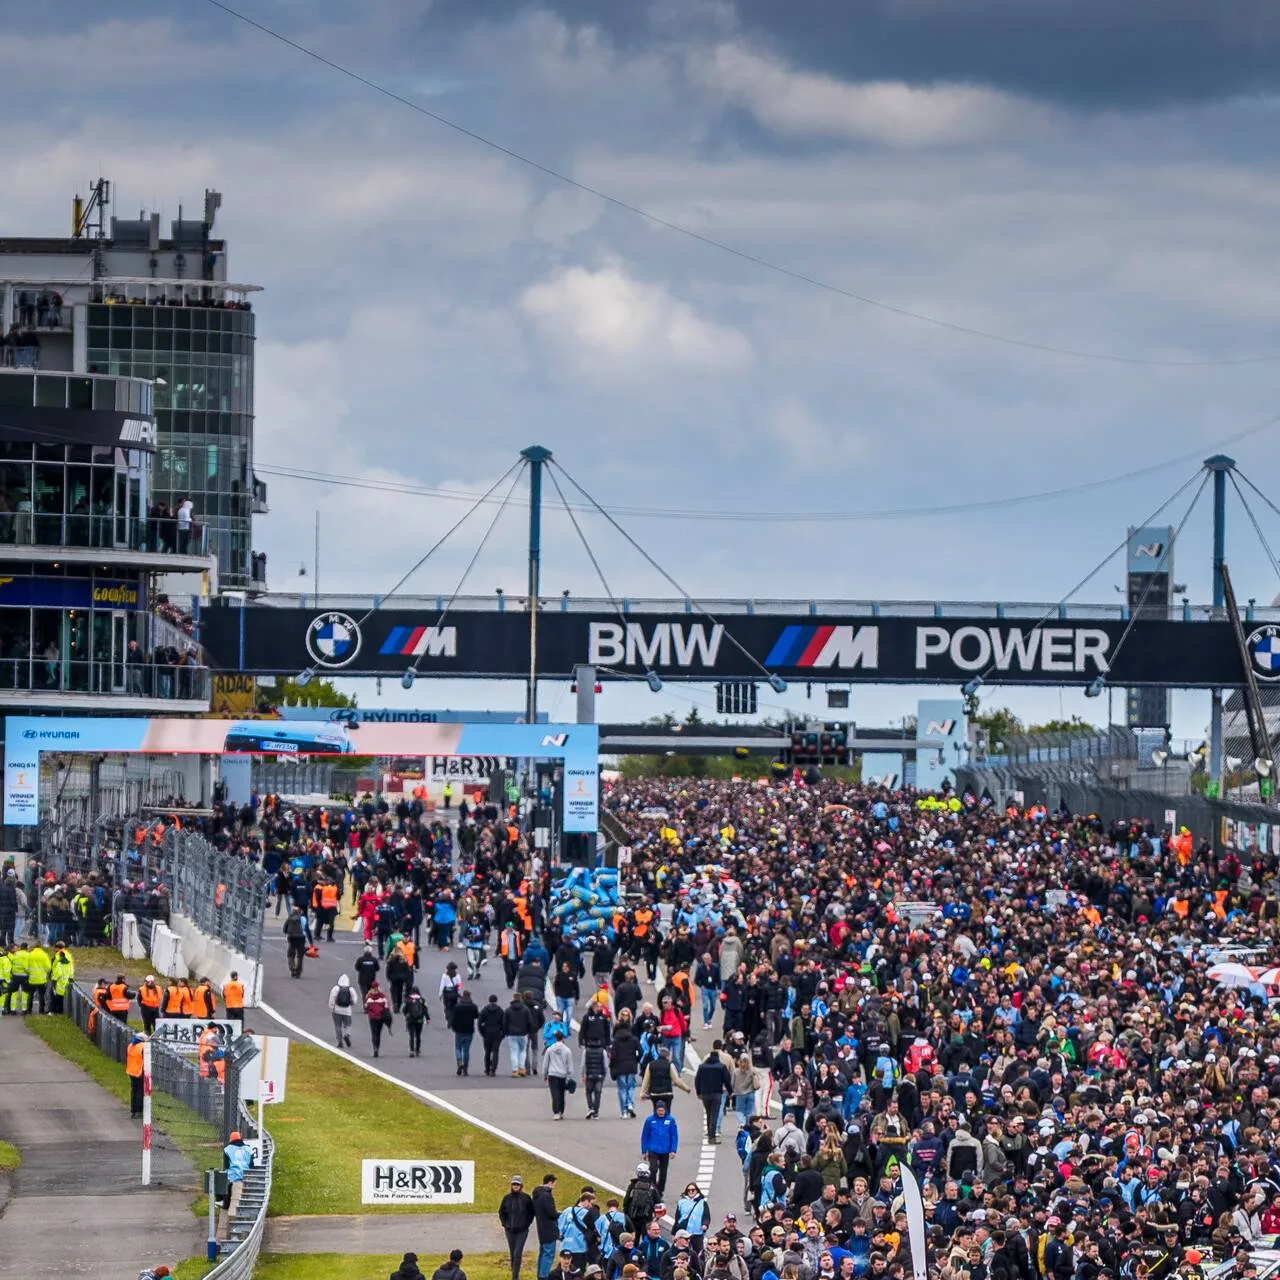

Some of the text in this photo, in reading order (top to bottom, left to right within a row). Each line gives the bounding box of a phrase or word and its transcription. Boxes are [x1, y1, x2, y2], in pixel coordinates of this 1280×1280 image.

[589, 622, 724, 666] BMW
[916, 626, 1110, 672] POWER
[216, 675, 253, 694] ADAC
[39, 730, 80, 739] HYUNDAI
[375, 1165, 428, 1189] H&R
